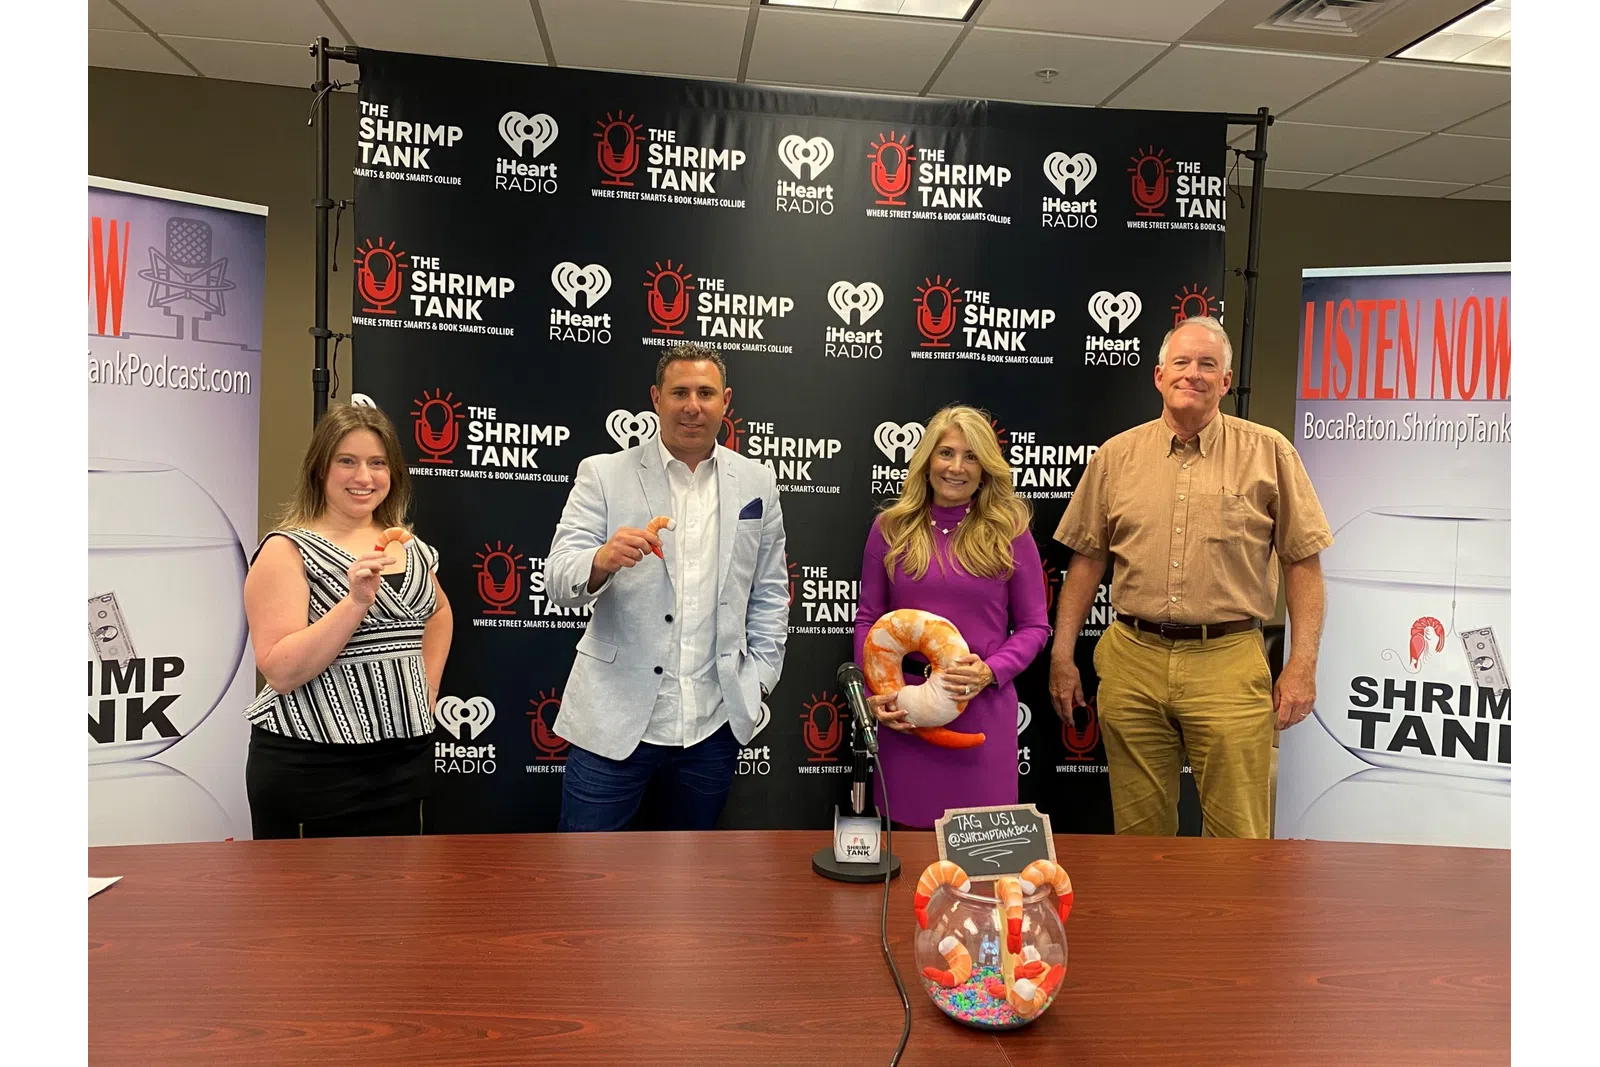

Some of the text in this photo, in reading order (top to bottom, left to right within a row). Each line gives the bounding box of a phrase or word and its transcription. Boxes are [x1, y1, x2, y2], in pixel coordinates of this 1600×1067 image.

[360, 101, 388, 118] THE
[359, 117, 463, 147] SHRIMP
[648, 128, 676, 143] THE
[358, 141, 430, 170] TANK
[648, 143, 746, 171] SHRIMP
[918, 149, 945, 162] THE
[496, 158, 557, 178] iHeart
[918, 163, 1011, 187] SHRIMP
[1176, 162, 1200, 173] THE
[386, 172, 405, 180] BOOK
[406, 174, 433, 183] SMARTS
[434, 176, 462, 185] COLLIDE
[495, 175, 558, 194] RADIO
[647, 167, 716, 193] TANK
[591, 188, 746, 208] WHERE STREET SMARTS & BOOK SMARTS COLLIDE
[776, 180, 833, 200] iHeart
[918, 187, 983, 208] TANK
[776, 198, 834, 215] RADIO
[1042, 196, 1097, 213] iHeart
[866, 209, 1011, 225] WHERE STREET SMARTS & BOOK SMARTS COLLIDE
[1042, 214, 1098, 228] RADIO
[411, 256, 440, 270] THE
[411, 271, 515, 298] SHRIMP
[698, 278, 724, 292] THE
[698, 293, 794, 318] SHRIMP
[964, 290, 990, 304] THE
[410, 295, 483, 321] TANK
[964, 305, 1056, 329] SHRIMP
[352, 316, 514, 336] WHERE STREET SMARTS & BOOK SMARTS COLLIDE
[550, 308, 611, 328] iHeart
[550, 326, 612, 344] RADIO
[697, 316, 764, 340] TANK
[826, 326, 882, 344] iHeart
[642, 337, 666, 346] WHERE
[742, 343, 766, 352] SMARTS
[768, 345, 793, 354] COLLIDE
[963, 328, 1026, 351] TANK
[1085, 335, 1140, 352] iHeart
[1301, 296, 1512, 401] LISTEN NOW
[825, 344, 883, 360] RADIO
[911, 351, 932, 360] WHERE
[933, 352, 955, 360] STREET
[956, 352, 980, 361] SMARTS
[987, 354, 1004, 363] BOOK
[1005, 355, 1028, 363] SMARTS
[1029, 356, 1054, 364] COLLIDE
[1085, 352, 1140, 366] RADIO
[468, 406, 496, 420] THE
[468, 420, 570, 446] SHRIMP
[748, 421, 774, 434] THE
[1304, 412, 1512, 449] BocaRaton.ShrimpTank
[1010, 432, 1035, 443] THE
[748, 436, 842, 459] SHRIMP
[467, 445, 538, 469] TANK
[408, 467, 569, 483] WHERE STREET SMARTS & BOOK SMARTS COLLIDE
[872, 464, 909, 480] iHea
[1009, 468, 1072, 487] TANK
[790, 485, 814, 493] SMARTS
[816, 486, 840, 494] COLLIDE
[529, 558, 546, 569] TH
[802, 566, 828, 578] THE
[802, 580, 861, 600] SHRI
[473, 619, 497, 627] WHERE
[435, 742, 495, 759] iHeart
[435, 759, 496, 774] RADIO
[952, 812, 1016, 831] TAG US!
[948, 824, 1038, 847] @SHRIMPTANKBOCA
